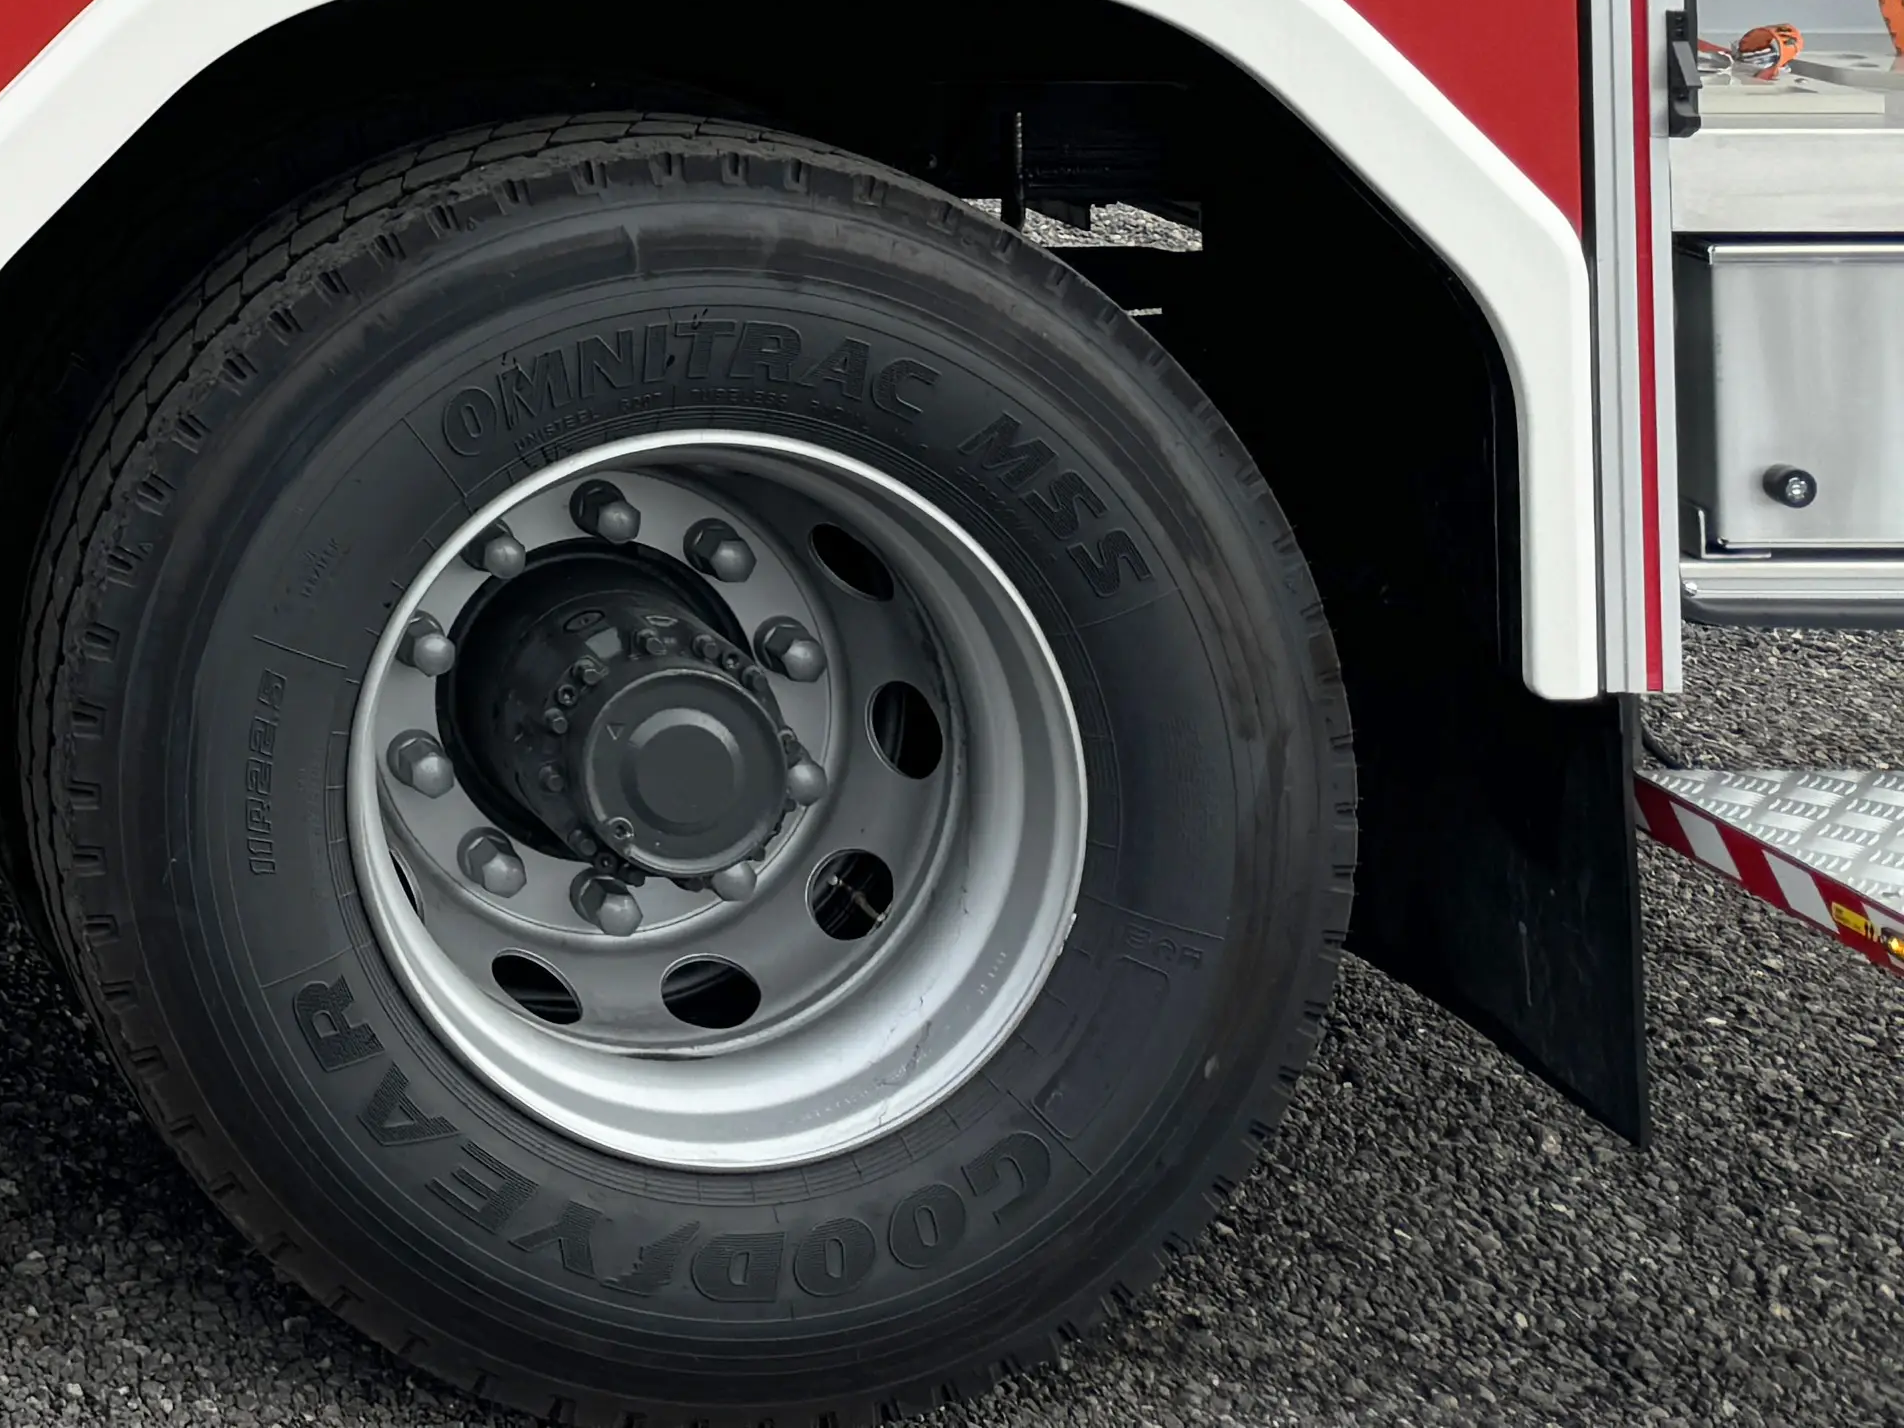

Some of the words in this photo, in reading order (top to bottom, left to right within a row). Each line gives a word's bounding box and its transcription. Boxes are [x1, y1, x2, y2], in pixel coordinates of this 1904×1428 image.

[443, 319, 942, 456] OMNITRAC
[957, 409, 1155, 598] MSS
[292, 972, 1053, 1303] GOODYEAR
